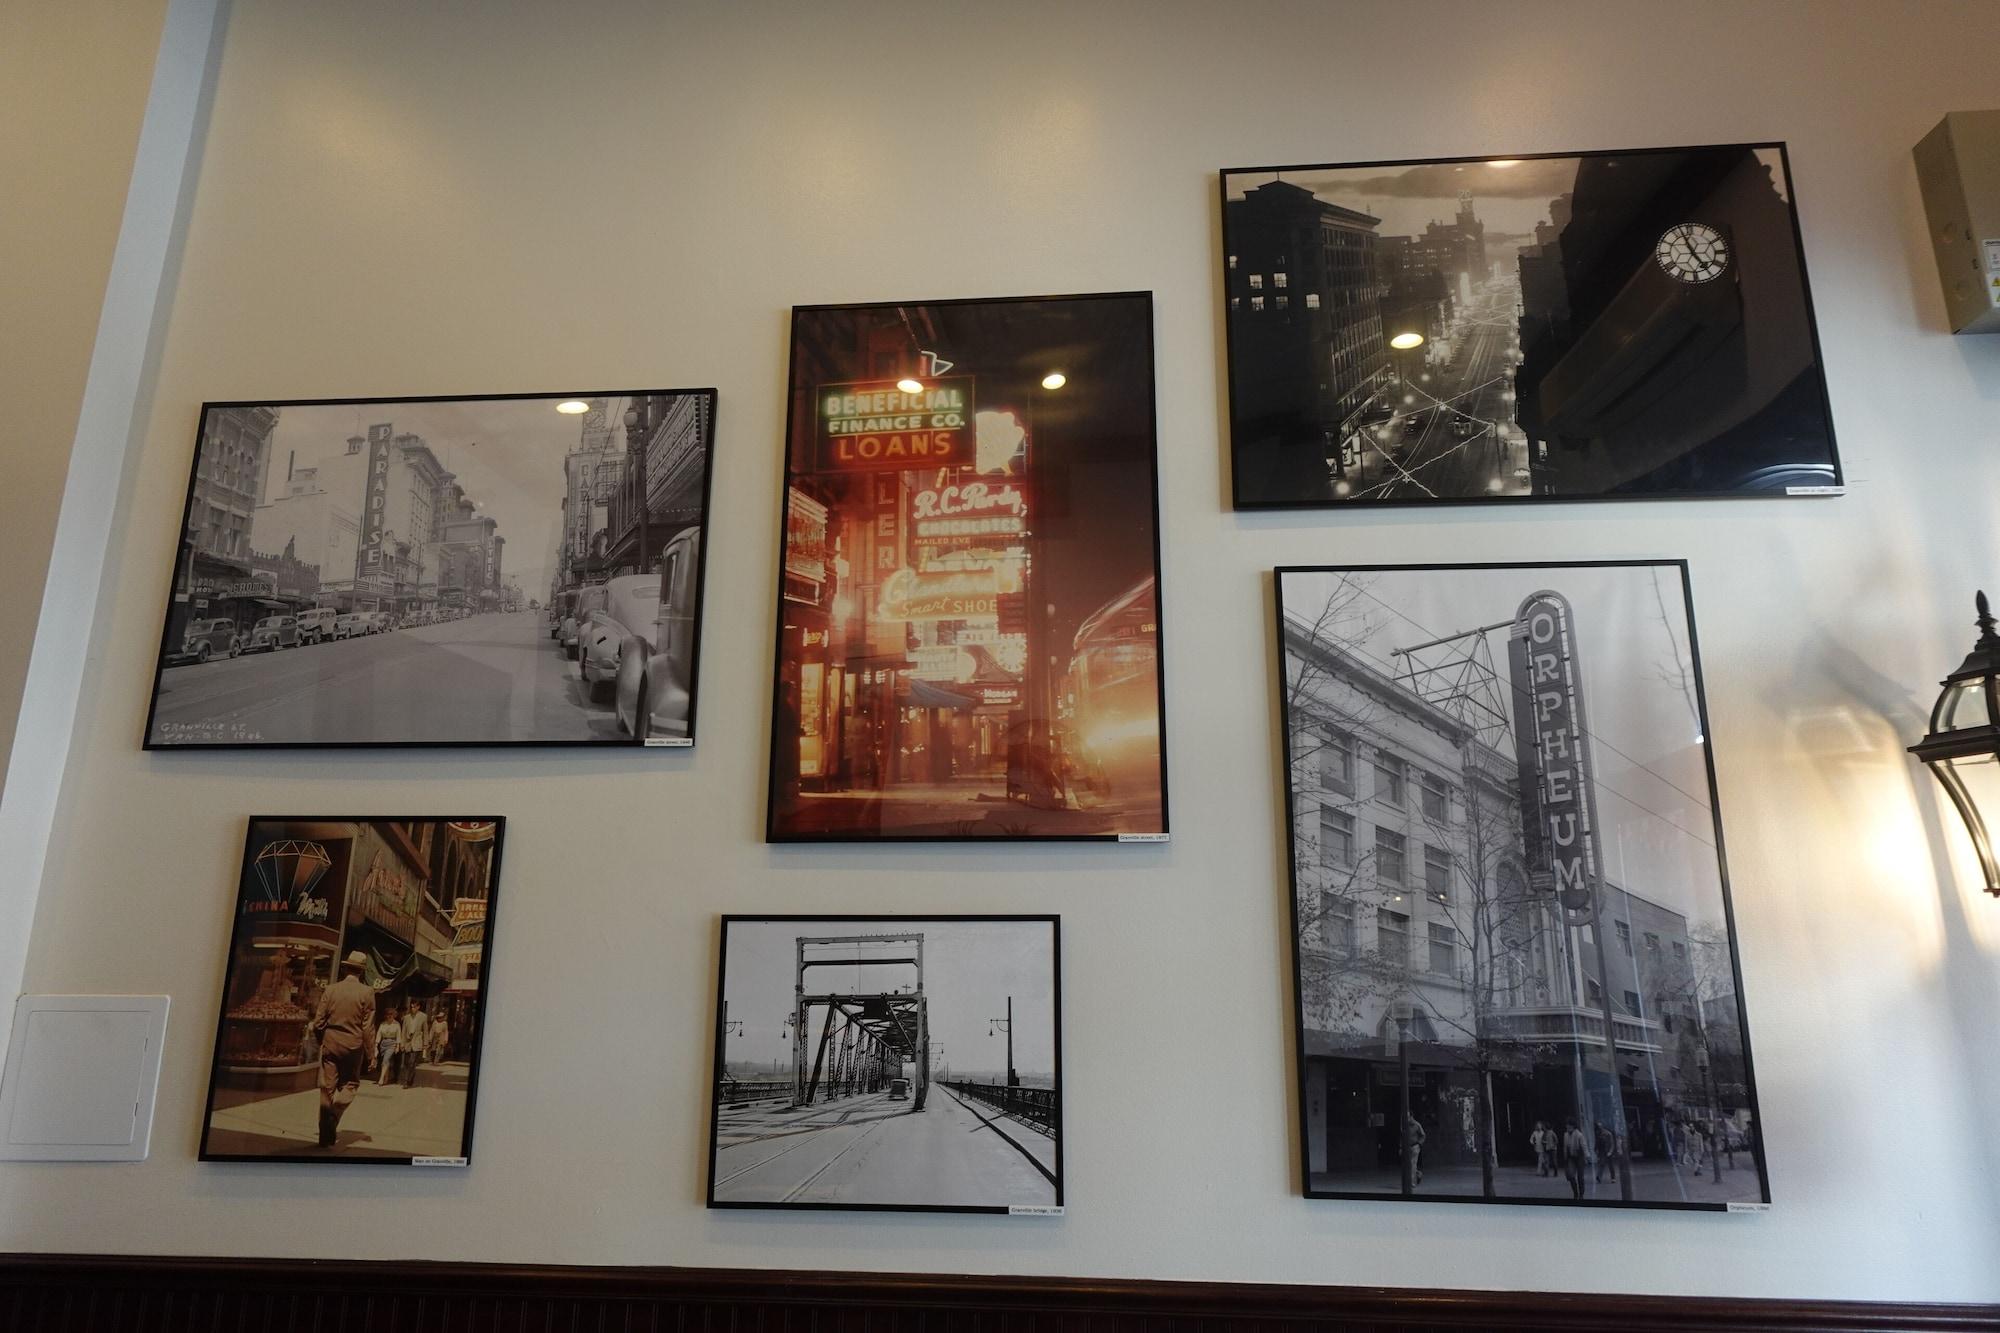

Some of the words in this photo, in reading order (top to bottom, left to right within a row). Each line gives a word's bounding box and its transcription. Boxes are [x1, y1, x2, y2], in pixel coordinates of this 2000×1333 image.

[826, 389, 963, 417] BENEFICIAL
[828, 415, 923, 434] FINANCE
[931, 412, 966, 429] CO.
[839, 432, 952, 461] LOANS
[367, 423, 393, 563] PARADISE
[914, 537, 950, 545] MAILED
[900, 596, 950, 618] Smart
[1140, 622, 1157, 633] GR
[1529, 612, 1585, 892] ORPHEUM
